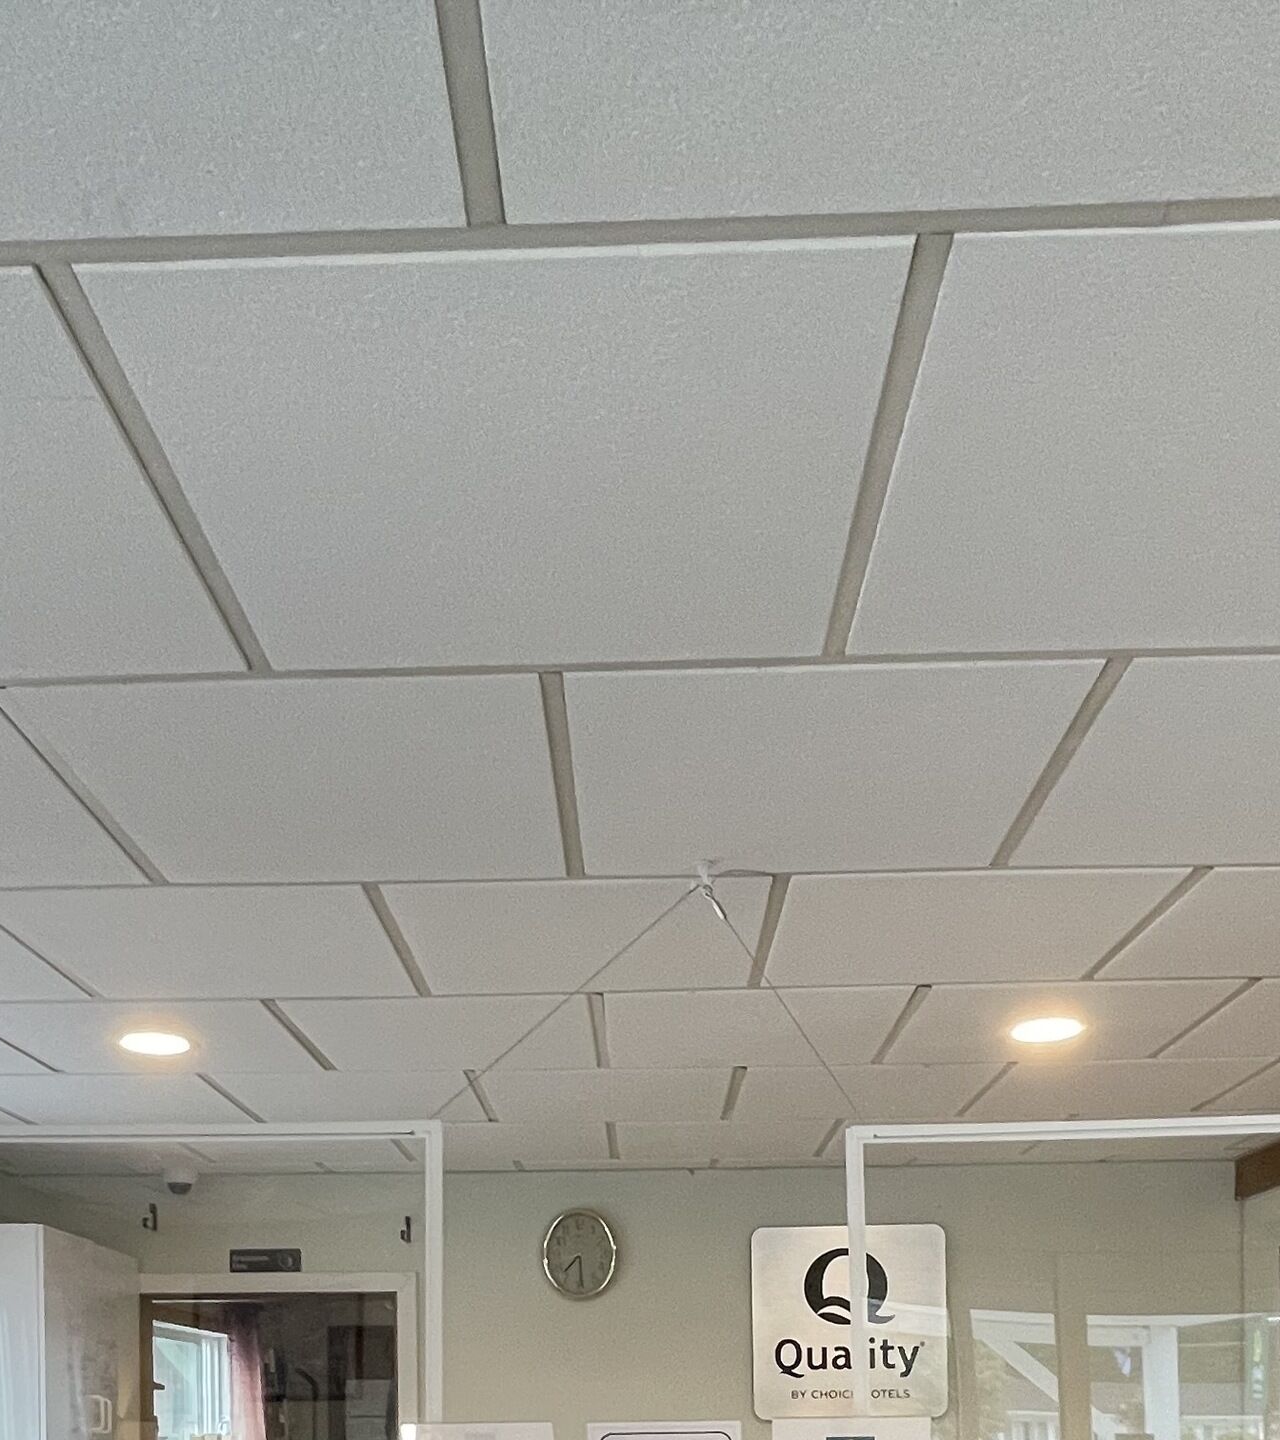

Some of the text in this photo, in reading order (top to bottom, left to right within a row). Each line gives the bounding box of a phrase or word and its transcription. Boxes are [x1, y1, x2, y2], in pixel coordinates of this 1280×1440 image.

[775, 1337, 920, 1378] Quaity
[791, 1389, 808, 1399] BY
[870, 1388, 911, 1399] OTELS
